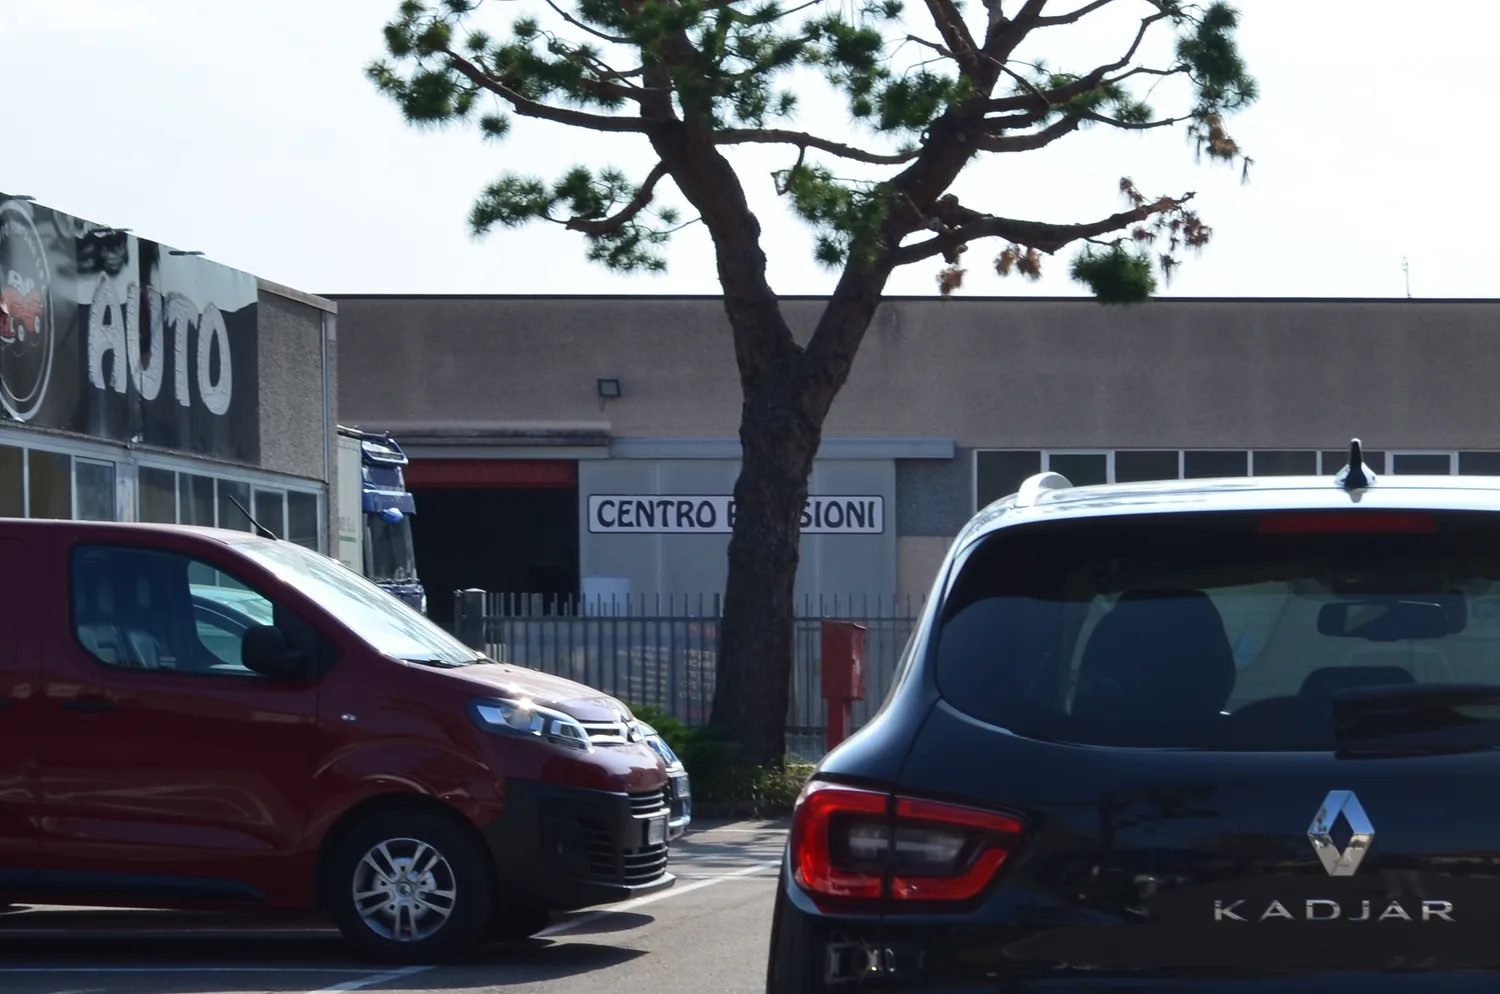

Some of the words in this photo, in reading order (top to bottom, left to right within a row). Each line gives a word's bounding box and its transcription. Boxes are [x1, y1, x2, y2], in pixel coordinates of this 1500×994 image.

[87, 271, 232, 415] AUTO
[597, 500, 716, 528] CENTRO
[727, 500, 875, 528] SIONI
[1213, 899, 1457, 922] KADJAR
